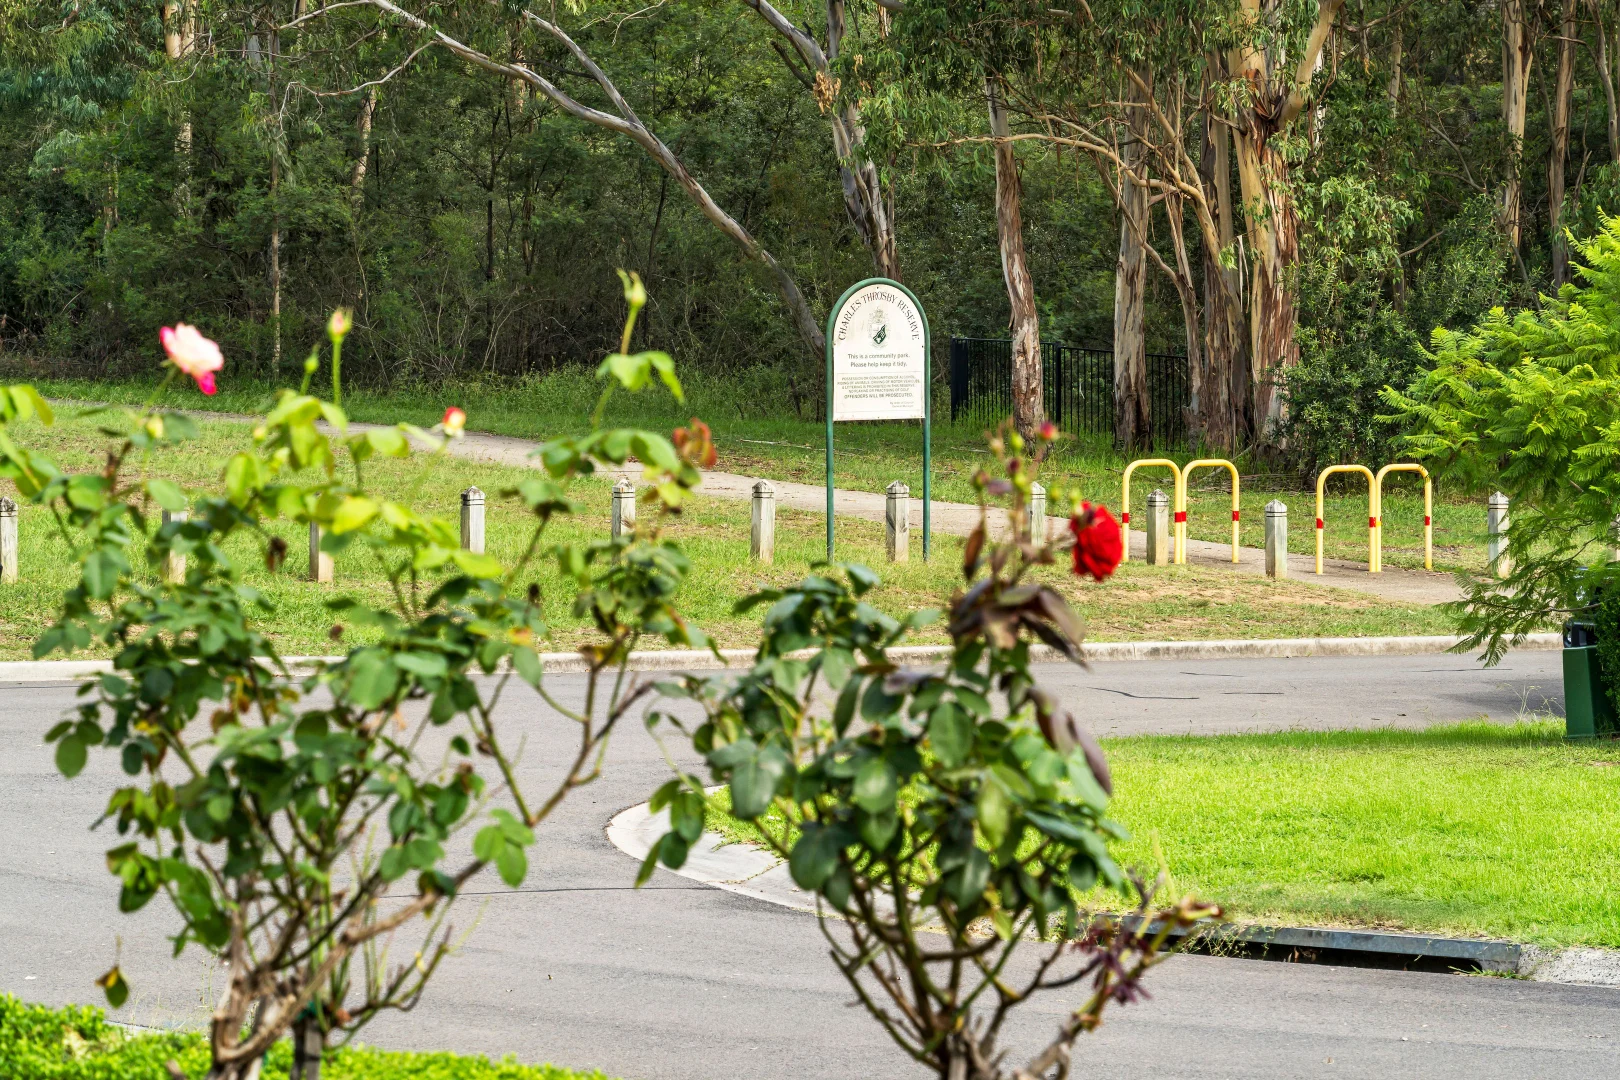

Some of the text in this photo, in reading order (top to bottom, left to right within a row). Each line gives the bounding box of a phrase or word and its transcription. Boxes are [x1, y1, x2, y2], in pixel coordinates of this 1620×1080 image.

[838, 292, 919, 340] CHARLES THROSBY RESERVE
